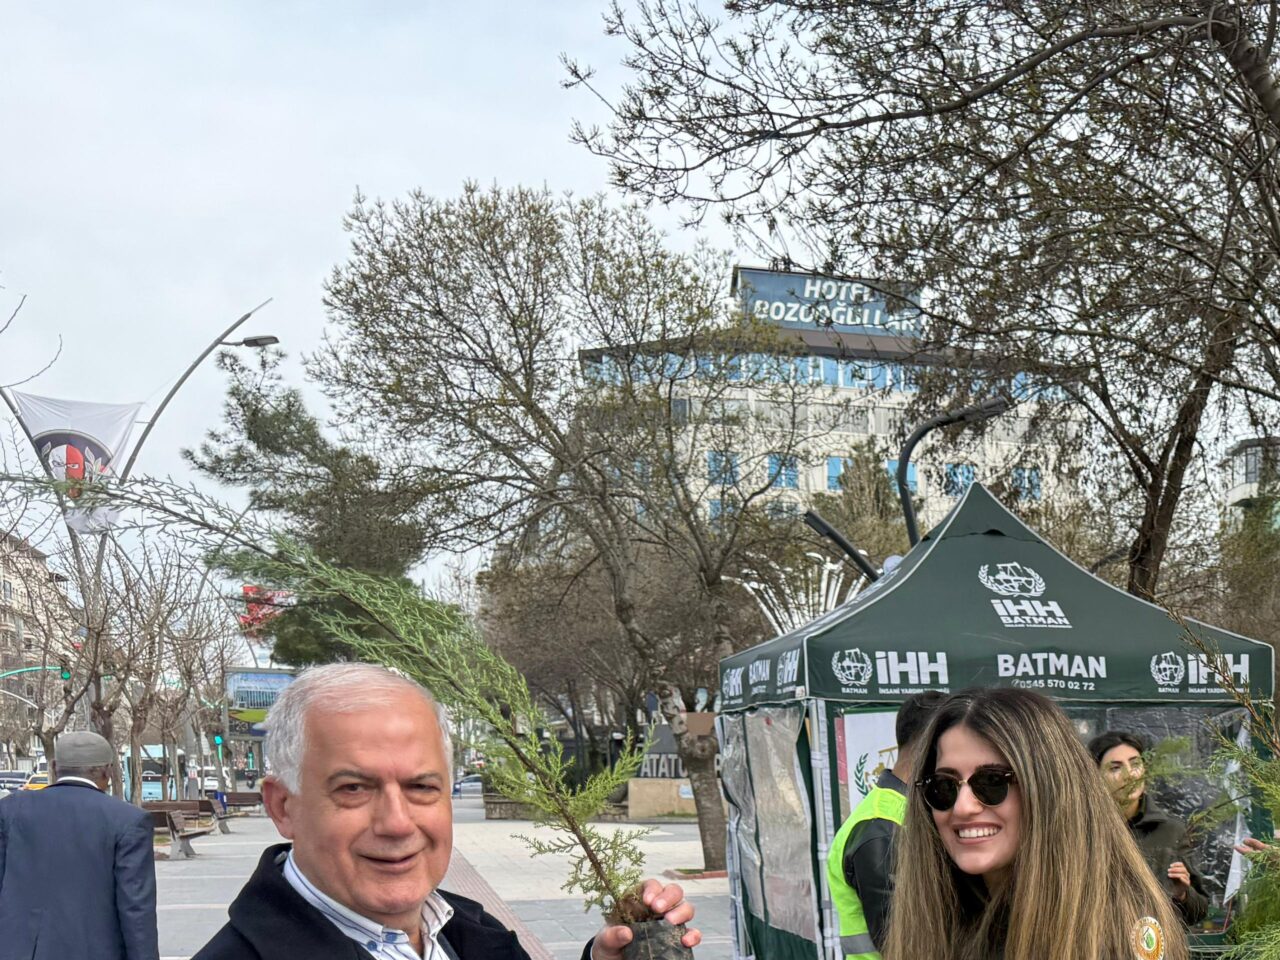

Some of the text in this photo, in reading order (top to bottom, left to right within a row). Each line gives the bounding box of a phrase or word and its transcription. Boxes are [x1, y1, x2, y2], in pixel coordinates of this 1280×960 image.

[804, 279, 873, 302] HOTEL
[1000, 616, 1070, 625] BATMAN
[997, 652, 1107, 678] BATMAN
[1047, 679, 1065, 688] 570
[1068, 681, 1081, 689] 02
[1083, 682, 1096, 690] 72
